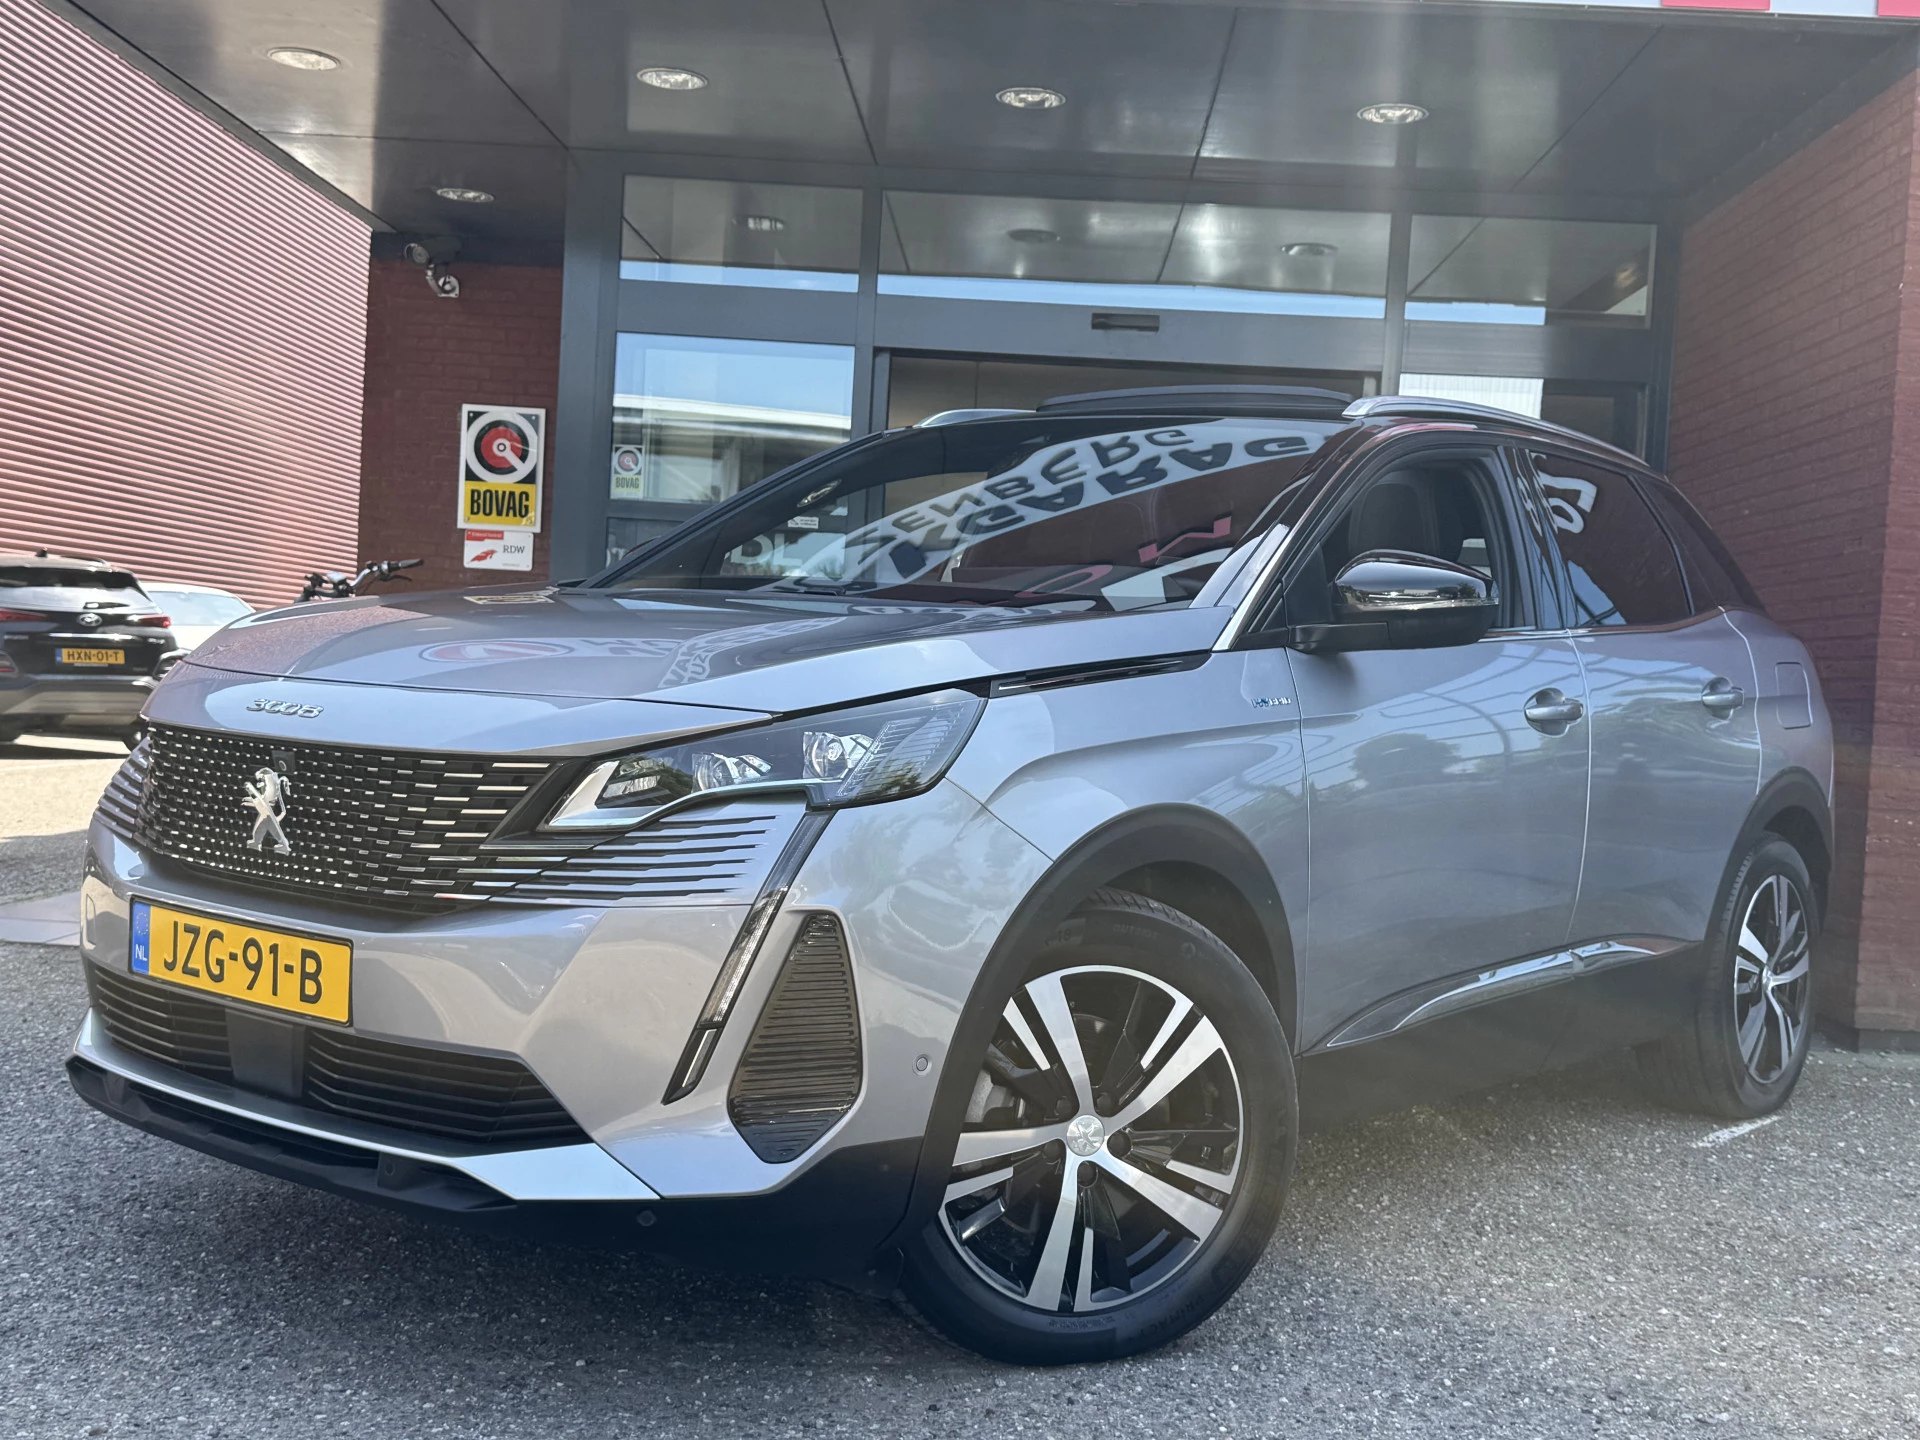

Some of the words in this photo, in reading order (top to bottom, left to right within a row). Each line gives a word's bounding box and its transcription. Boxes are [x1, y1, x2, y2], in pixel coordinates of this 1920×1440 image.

[615, 477, 640, 489] BOVAG
[470, 488, 530, 518] BOVAG
[503, 545, 525, 554] RDW
[67, 650, 119, 661] HXN-01-T
[246, 698, 325, 718] 3008
[135, 944, 148, 961] NL
[163, 920, 323, 1004] JZG-91-B
